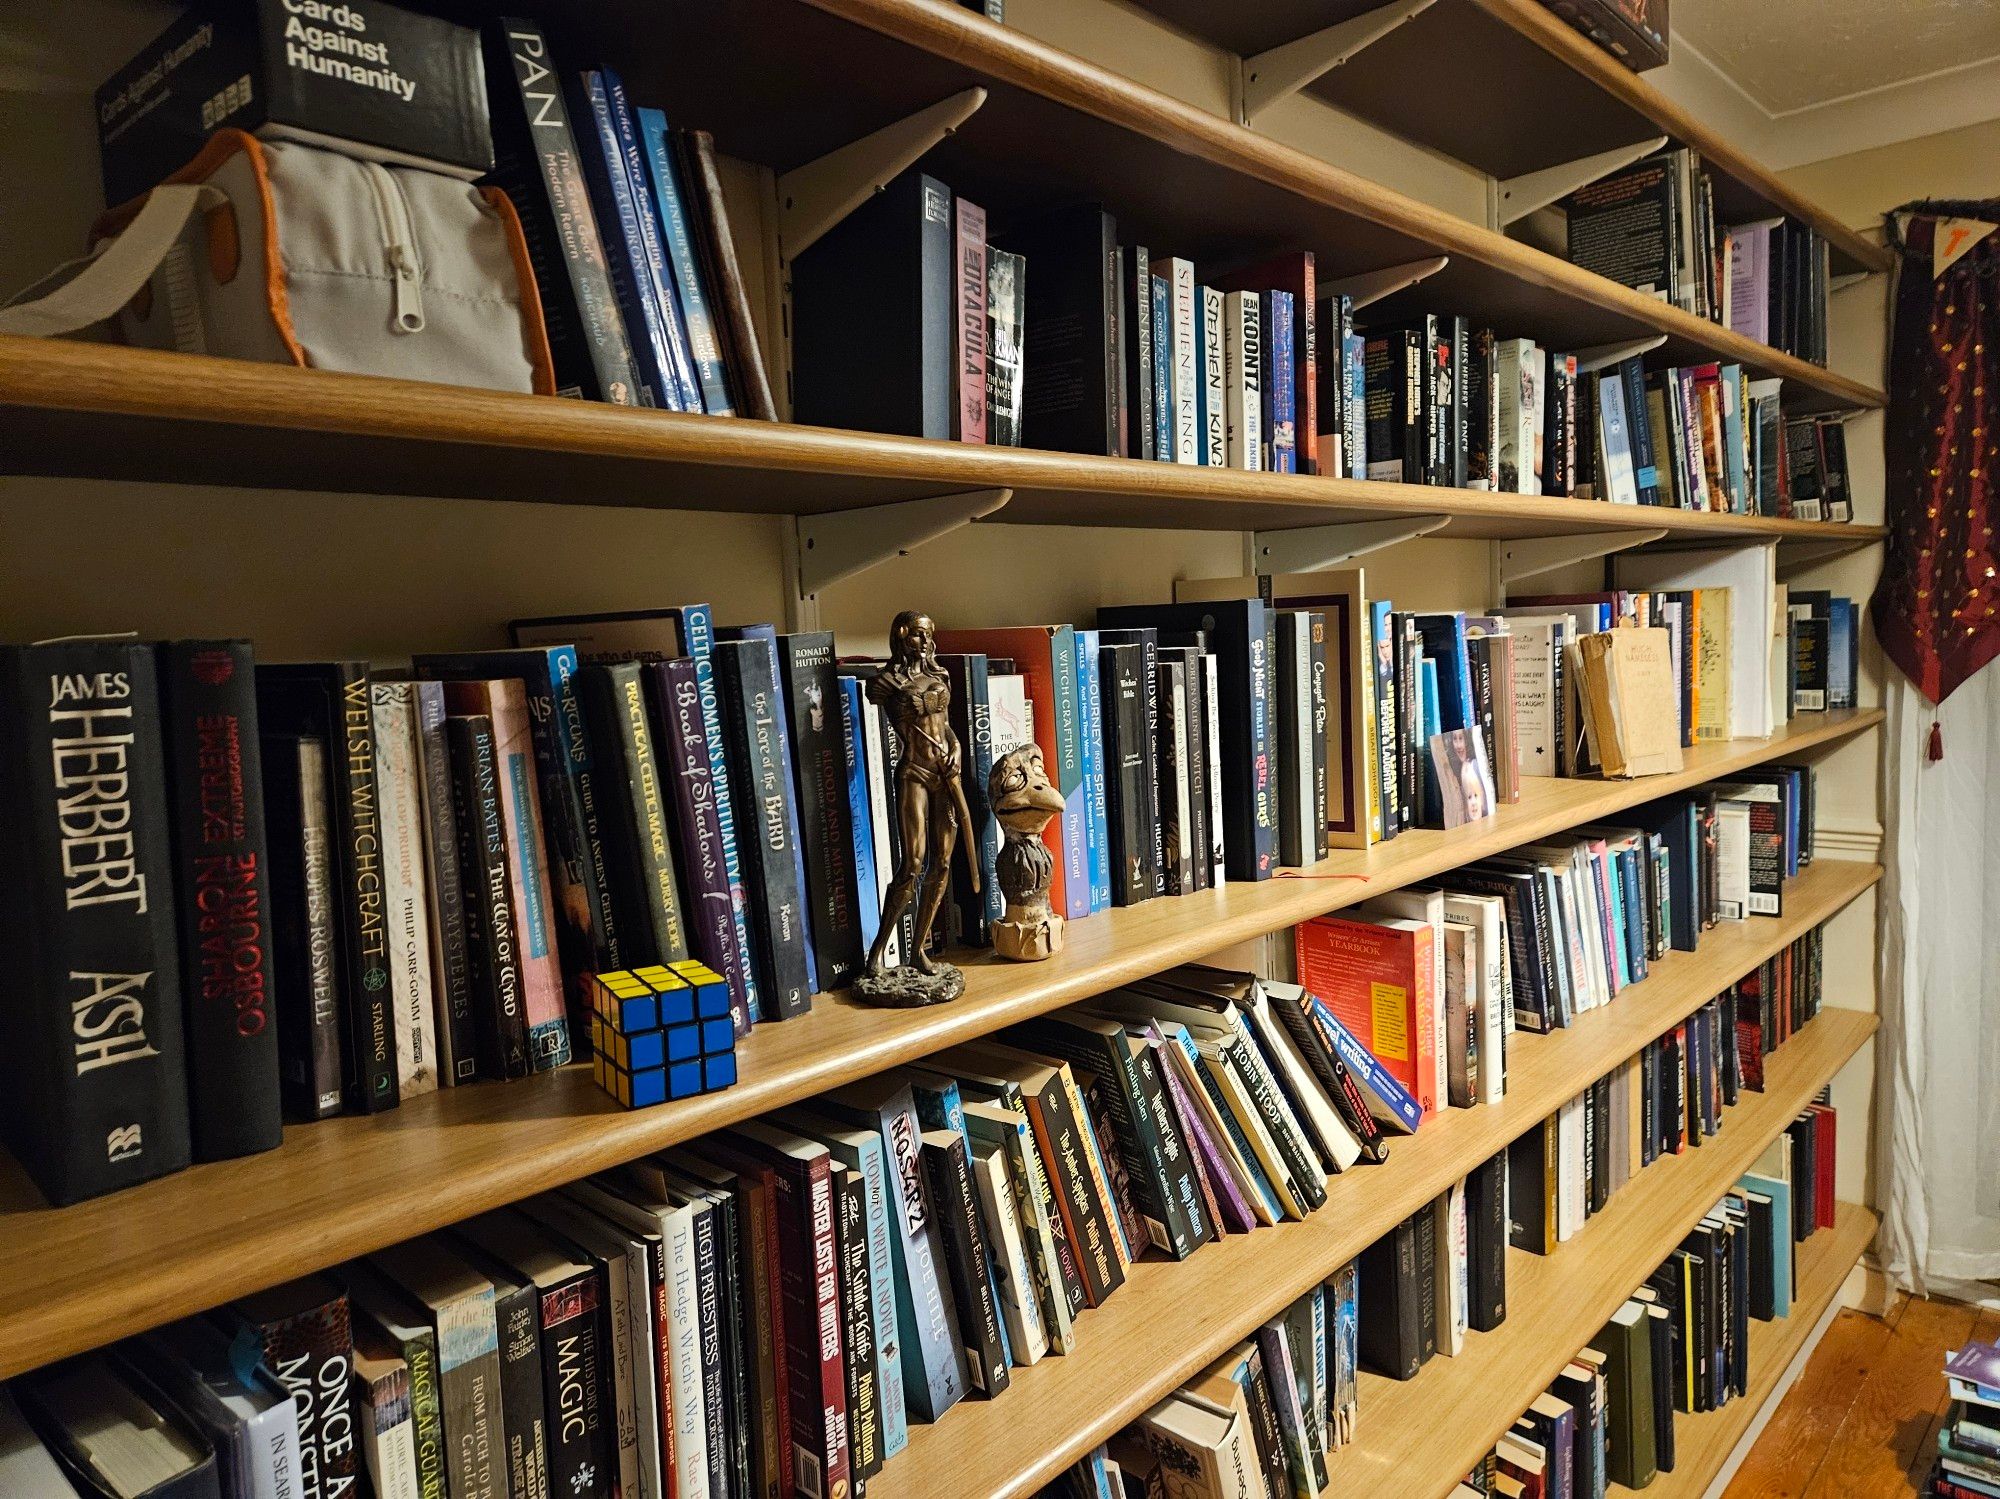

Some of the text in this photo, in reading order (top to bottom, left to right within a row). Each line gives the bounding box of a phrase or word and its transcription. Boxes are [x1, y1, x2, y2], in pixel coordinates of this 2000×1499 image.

[284, 0, 366, 32] Cards
[285, 16, 390, 65] Against
[287, 43, 416, 101] Humanity
[508, 31, 563, 129] PAN
[544, 153, 579, 259] Modern Return
[558, 150, 572, 176] The
[655, 147, 690, 258] WITCHFINDER'S
[682, 262, 701, 304] SISTER
[963, 260, 984, 376] DRACULA
[1138, 253, 1151, 369] STEPHEN KING
[1157, 311, 1165, 362] KOONTZ'S
[1243, 309, 1259, 393] KOONTZ
[1306, 265, 1316, 374] BECOMING WRITER
[1178, 267, 1193, 455] STEPHEN KING
[1206, 293, 1223, 467] STEPHEN KING
[1461, 329, 1469, 408] JAMES HERBERT
[49, 672, 131, 709] JAMES
[795, 646, 830, 657] RONALD
[795, 657, 831, 668] HUTTON
[1313, 660, 1326, 704] Conjugal
[427, 699, 441, 746] PHILIP
[561, 697, 586, 763] RITUALS
[688, 611, 742, 878] CELTIC WOMEN'S SPIRITUALITY
[838, 692, 855, 768] FAMILIARS
[1090, 674, 1101, 747] JOURNEY
[1145, 641, 1163, 867] CERRIDWEN HUGHES
[1188, 653, 1202, 796] DOREEN VALIENTE WITCH
[1315, 705, 1327, 734] Rites
[1380, 699, 1392, 795] BEFORE & LAUGHTER
[49, 706, 150, 915] HERBERT
[674, 681, 720, 884] Book Shadows
[753, 692, 786, 851] The Lore of the BARD
[1059, 650, 1082, 879] WITCH CRAFTING Phyllis Curott
[1095, 773, 1105, 819] SPIRIT
[1255, 701, 1271, 829] STORIES REBEL GIRLS
[1370, 757, 1378, 808] JOHNSON
[194, 715, 230, 1001] SHARON EXTREME
[342, 677, 386, 958] WELSH WITCHCRAFT
[475, 732, 511, 964] BRIAN BATES THE WAY OF
[623, 680, 682, 952] PRACTICAL CELTIC MAGIC MURRY HOPE
[1099, 832, 1107, 874] HUGHES
[777, 903, 793, 942] Rowan
[986, 840, 1001, 910] Jessica Macbeth
[228, 851, 267, 1037] OSBOURNE
[308, 926, 337, 1022] ROSWELL
[402, 897, 421, 1022] PHILIP CARR-GOMM
[1329, 938, 1381, 956] YEARBOOK
[1543, 954, 1554, 990] WORLD
[68, 969, 161, 1077] ASH
[371, 1001, 387, 1062] STARLING
[1506, 996, 1514, 1019] GOOD
[1340, 1038, 1372, 1080] writing
[1124, 1056, 1176, 1214] Finding Elen Caroline Wise
[1230, 1045, 1258, 1087] ROBIN
[1252, 1085, 1282, 1126] HOOD
[1280, 1127, 1295, 1148] DAVID
[1291, 1147, 1308, 1173] BALDWIN
[1586, 1108, 1594, 1180] MIDDLETON
[864, 1150, 889, 1276] HOW NOT WRITE
[1164, 1129, 1206, 1237] Lights Philip Pullman
[696, 1216, 719, 1366] HIGH PRIESTESS
[811, 1178, 839, 1361] MASTER LISTS FOR WRITERS
[957, 1160, 996, 1343] THE REAL MIDDLE EARTH BRIAN BATES
[1058, 1246, 1075, 1281] HOWE
[1084, 1215, 1111, 1289] Philip Pullman
[1111, 1235, 1126, 1266] QUEER
[657, 1244, 676, 1465] BUTLER MAGIC PURPOSE
[672, 1227, 698, 1435] The Hedge Witch's Way
[850, 1239, 878, 1467] The Philip Pullman
[1313, 1294, 1325, 1390] DEAN KOONTZ
[317, 1353, 356, 1499] ONCE A
[411, 1348, 434, 1439] MAGICAL
[471, 1373, 491, 1484] FROM PITCH TO
[556, 1335, 585, 1443] MAGIC
[705, 1373, 720, 1475] PATRICIA CROWTHER
[835, 1413, 847, 1451] BRYN
[1259, 1404, 1273, 1441] LEGENDS
[1299, 1408, 1321, 1461] HEX
